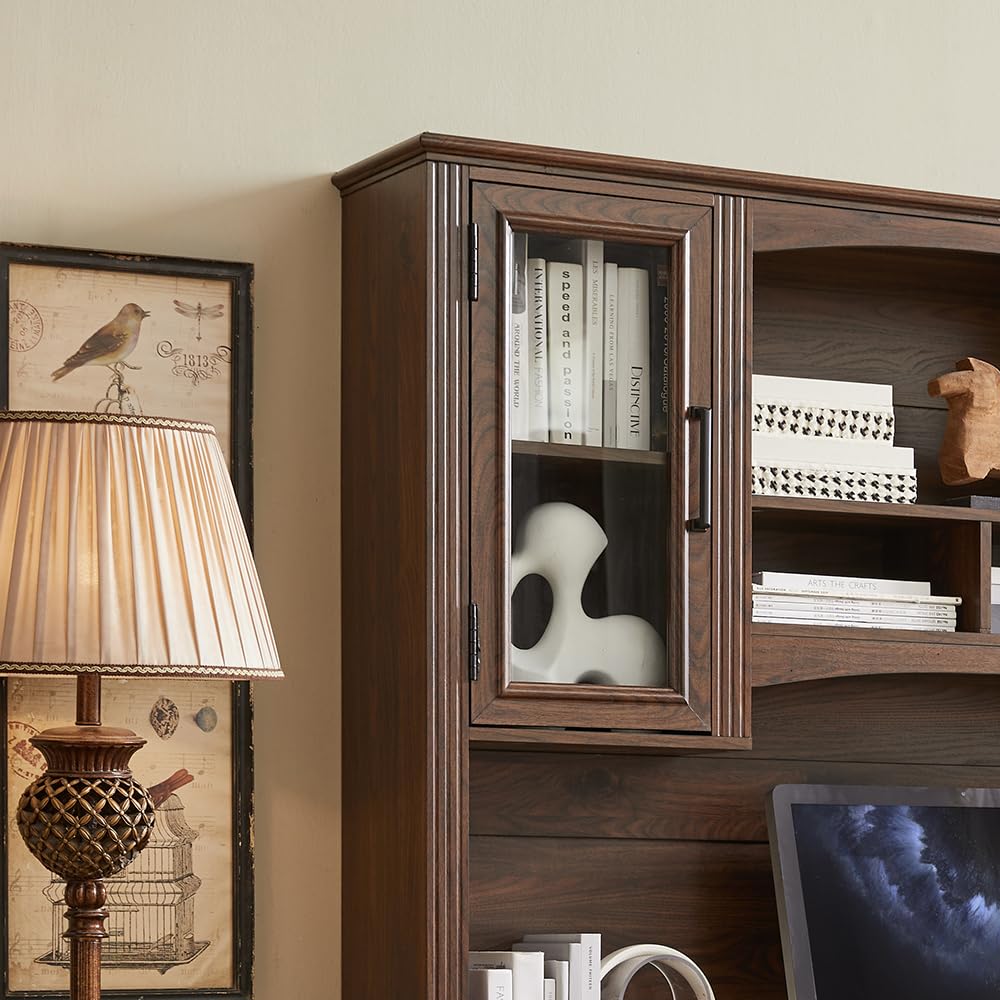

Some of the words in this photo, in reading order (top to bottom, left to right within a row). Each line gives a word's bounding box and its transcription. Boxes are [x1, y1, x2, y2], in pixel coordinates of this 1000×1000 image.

[561, 270, 571, 322] speed
[534, 267, 544, 363] INTERNATIONAL
[513, 323, 521, 357] AROUND
[562, 330, 571, 360] and
[183, 353, 209, 367] 1813
[513, 360, 521, 376] THE
[513, 379, 521, 408] WORLD
[534, 367, 544, 409] FASHION
[807, 579, 827, 587] ARTS
[830, 580, 845, 588] THE
[849, 581, 877, 590] CRAFTS
